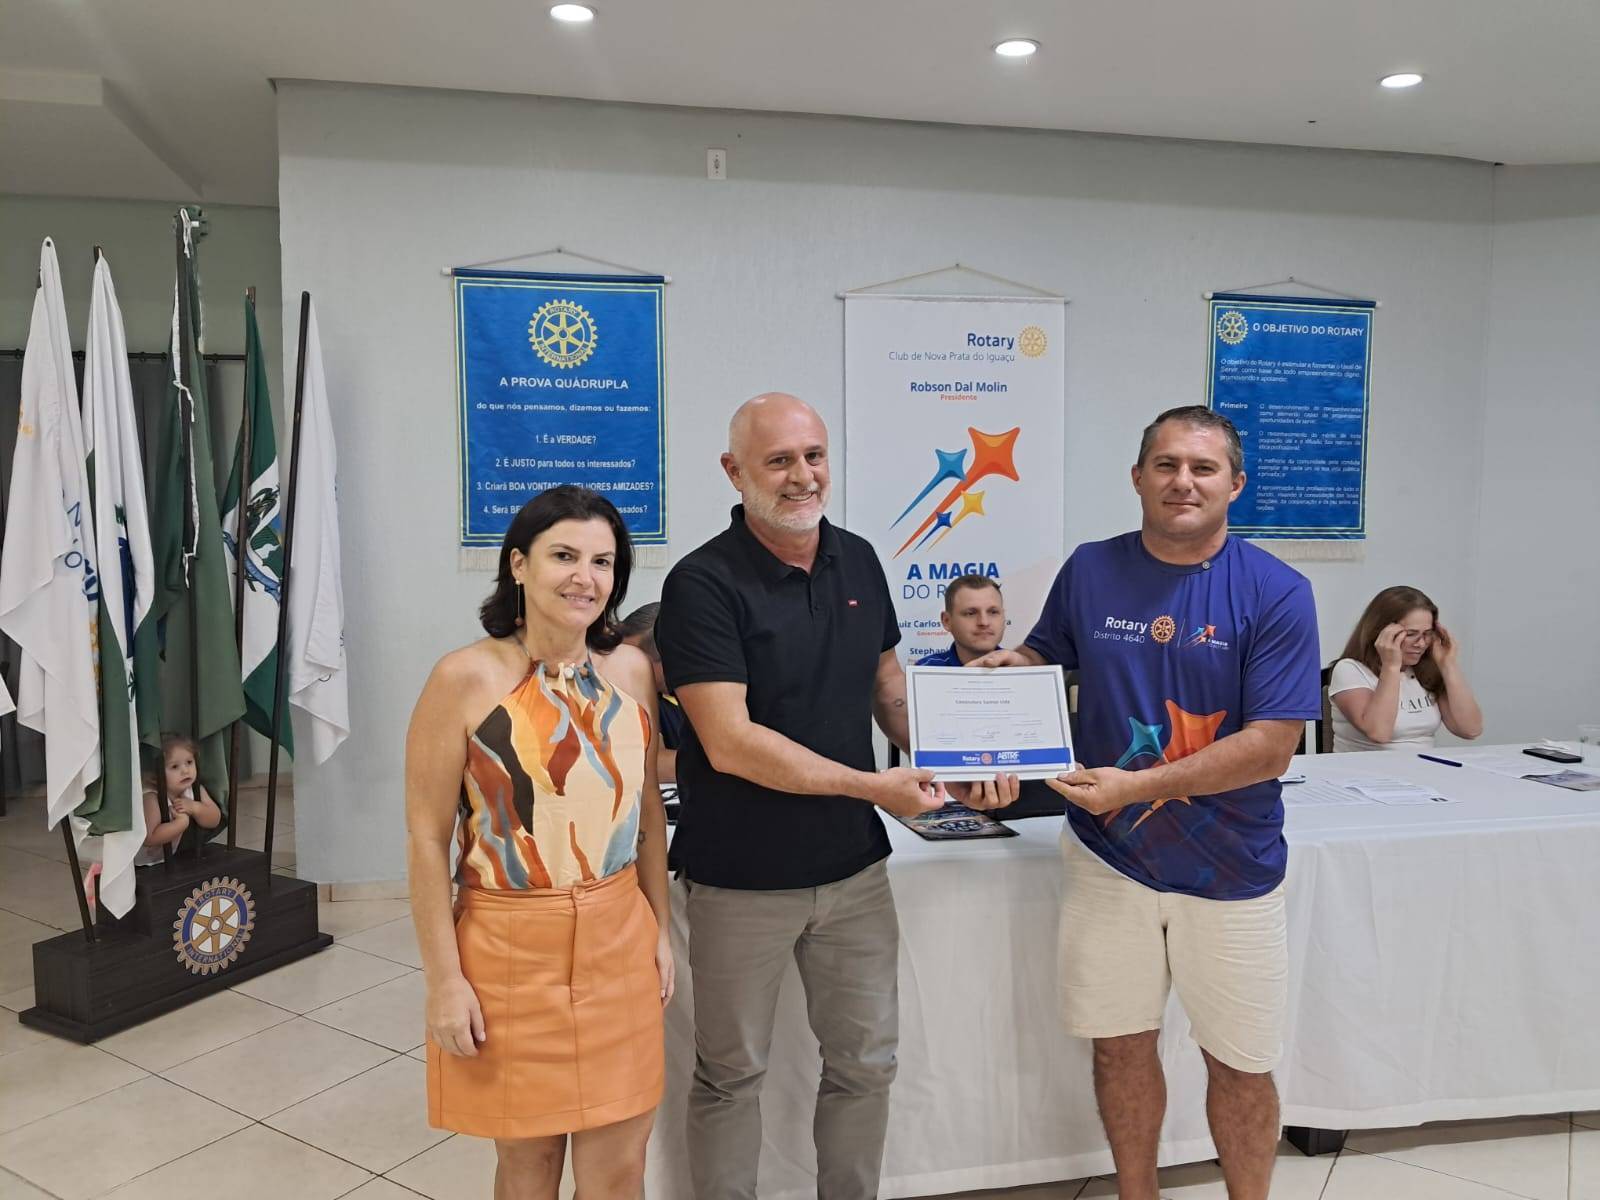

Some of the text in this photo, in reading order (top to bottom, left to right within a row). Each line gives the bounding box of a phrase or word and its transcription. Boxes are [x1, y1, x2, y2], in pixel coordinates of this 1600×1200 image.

[1253, 323, 1364, 336] O OBJETIVO DO ROTARY
[967, 333, 1015, 350] Rotary
[888, 352, 1015, 363] Club de Nova Prata do Iguaçu
[500, 377, 629, 389] A PROVA QUÁDRUPLA
[910, 382, 1008, 392] Robson Dal Molin
[940, 393, 978, 401] Presidente
[489, 403, 504, 411] que
[507, 402, 521, 410] nós
[569, 403, 601, 412] dizemos
[535, 435, 541, 443] 1.
[543, 434, 548, 443] É
[556, 435, 596, 444] VERDADE?
[510, 459, 536, 467] JUSTO
[537, 460, 553, 469] para
[555, 459, 575, 468] todos
[587, 459, 636, 468] interessados?
[476, 482, 483, 490] 3.
[485, 481, 507, 490] Criará
[508, 482, 526, 490] BOA
[613, 482, 654, 491] AMIZADES?
[483, 505, 489, 513] 4.
[492, 504, 508, 513] Será
[907, 562, 1000, 580] A MAGIA
[903, 584, 930, 599] DO
[898, 620, 941, 628] uiz Carlos
[1105, 616, 1148, 634] Rotary
[1093, 631, 1145, 644] Distrito 4640
